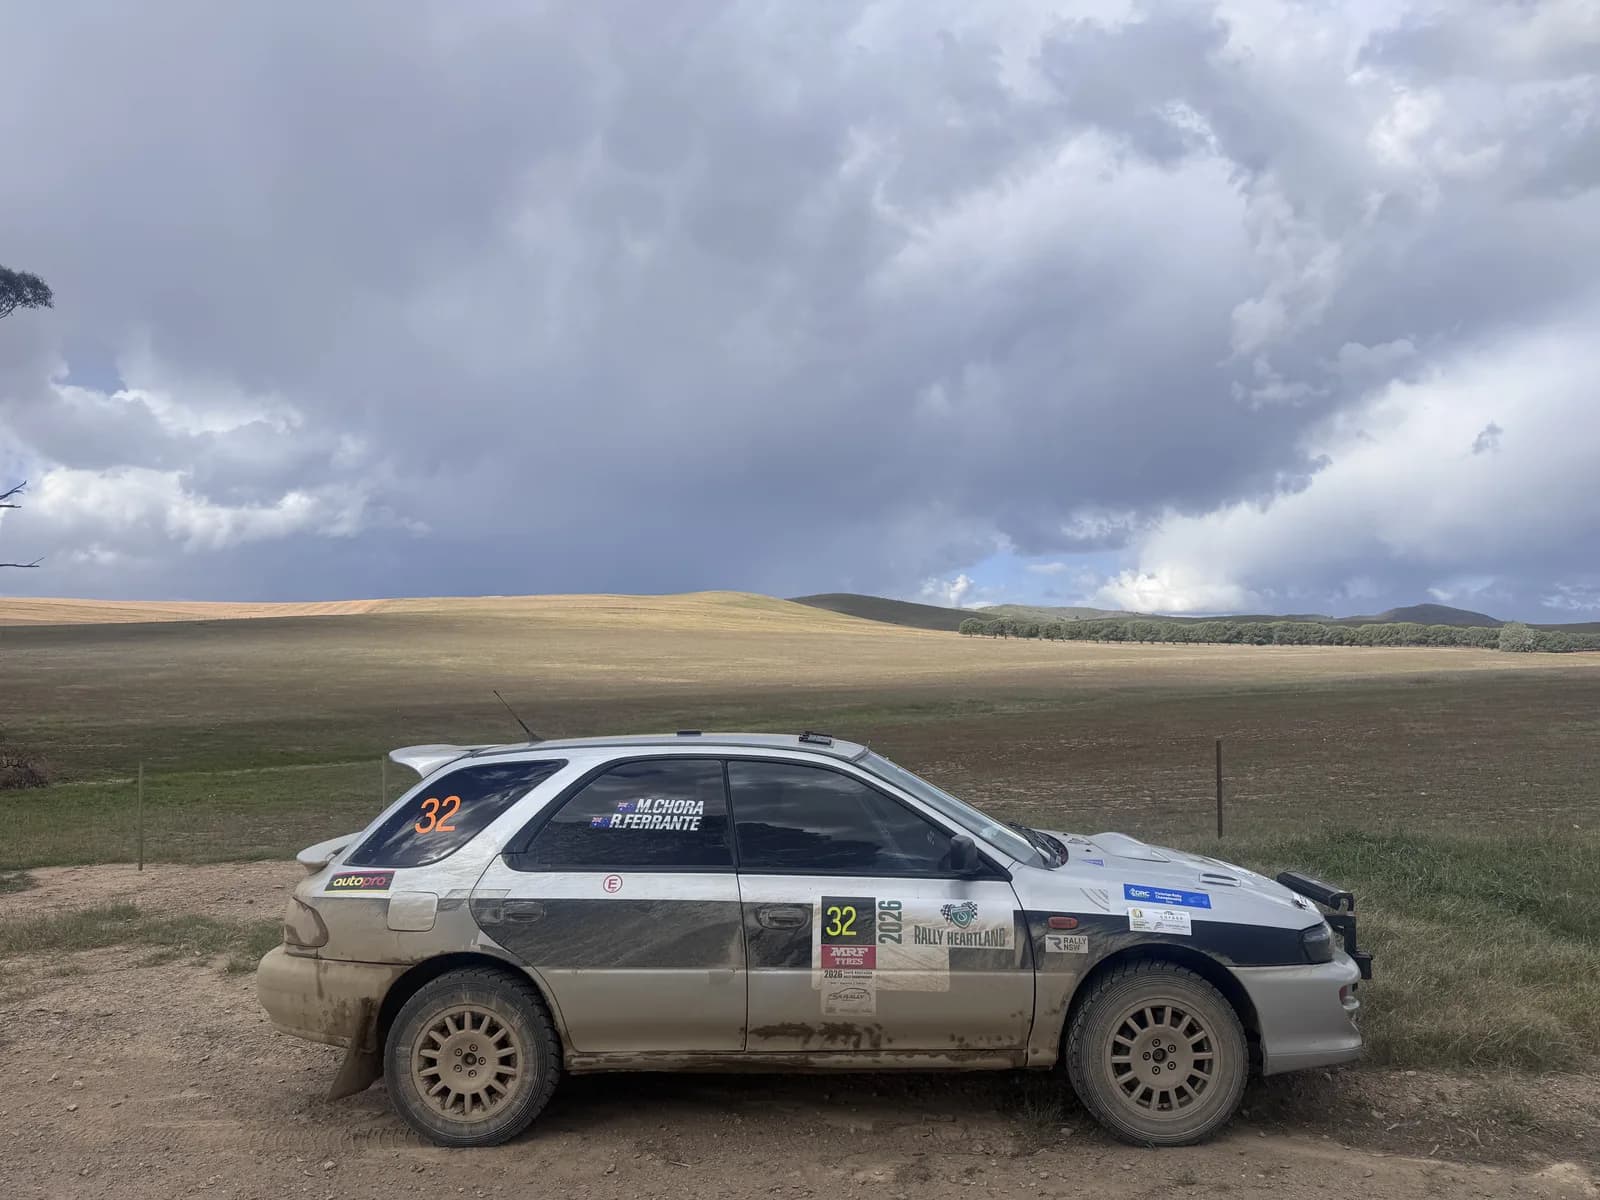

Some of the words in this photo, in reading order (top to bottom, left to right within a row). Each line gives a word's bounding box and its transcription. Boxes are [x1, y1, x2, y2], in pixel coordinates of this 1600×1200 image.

[415, 796, 461, 833] 32
[635, 799, 704, 815] M.CHORA
[609, 814, 702, 831] R.FERRANTE
[333, 876, 386, 887] autopro
[826, 906, 857, 936] 32
[878, 901, 902, 944] 2026
[914, 925, 943, 945] RALLY
[947, 928, 1005, 947] HEARTLAND
[1064, 937, 1087, 945] RALLY
[831, 947, 868, 957] MRF
[824, 970, 843, 979] 2026
